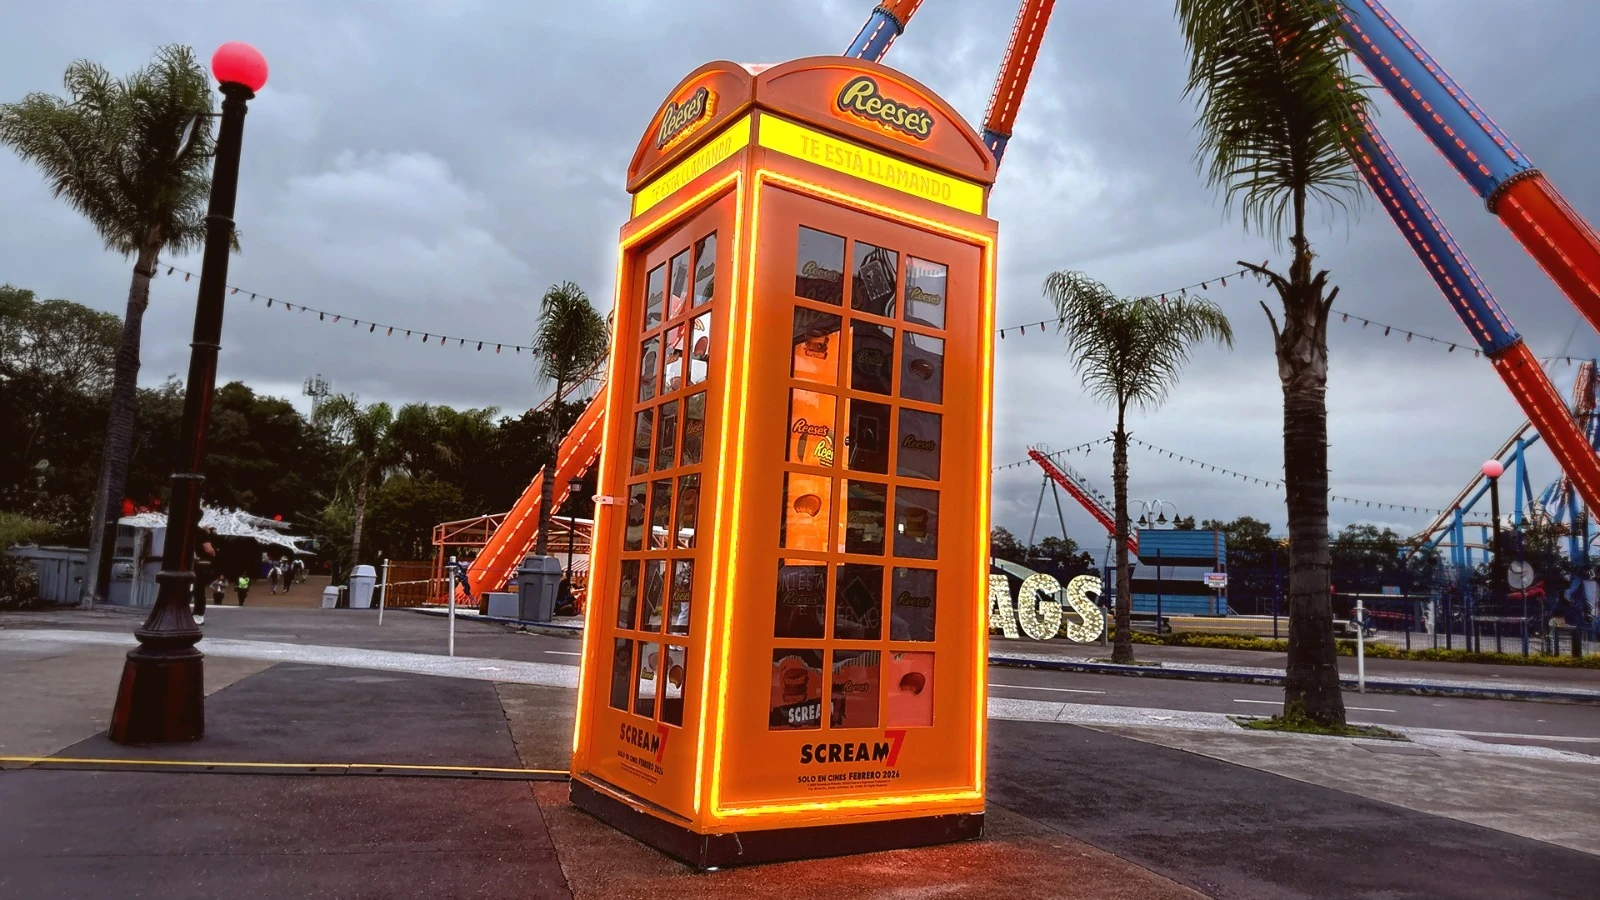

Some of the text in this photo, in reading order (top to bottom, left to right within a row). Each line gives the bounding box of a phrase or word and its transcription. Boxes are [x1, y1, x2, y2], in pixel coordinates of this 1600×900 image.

[657, 89, 704, 143] Reese's
[842, 79, 932, 135] Reese's
[682, 136, 733, 184] LLAMANDO
[801, 134, 819, 158] TE
[867, 157, 952, 201] LLAMANDO
[793, 418, 829, 436] Reese's
[619, 721, 670, 763] SCREAM 7
[800, 730, 906, 767] SCREAM 7
[798, 775, 816, 783] SOLO
[818, 774, 826, 782] EN
[829, 773, 847, 781] CINES
[849, 771, 881, 781] FEBRERO
[883, 770, 900, 779] 2026
